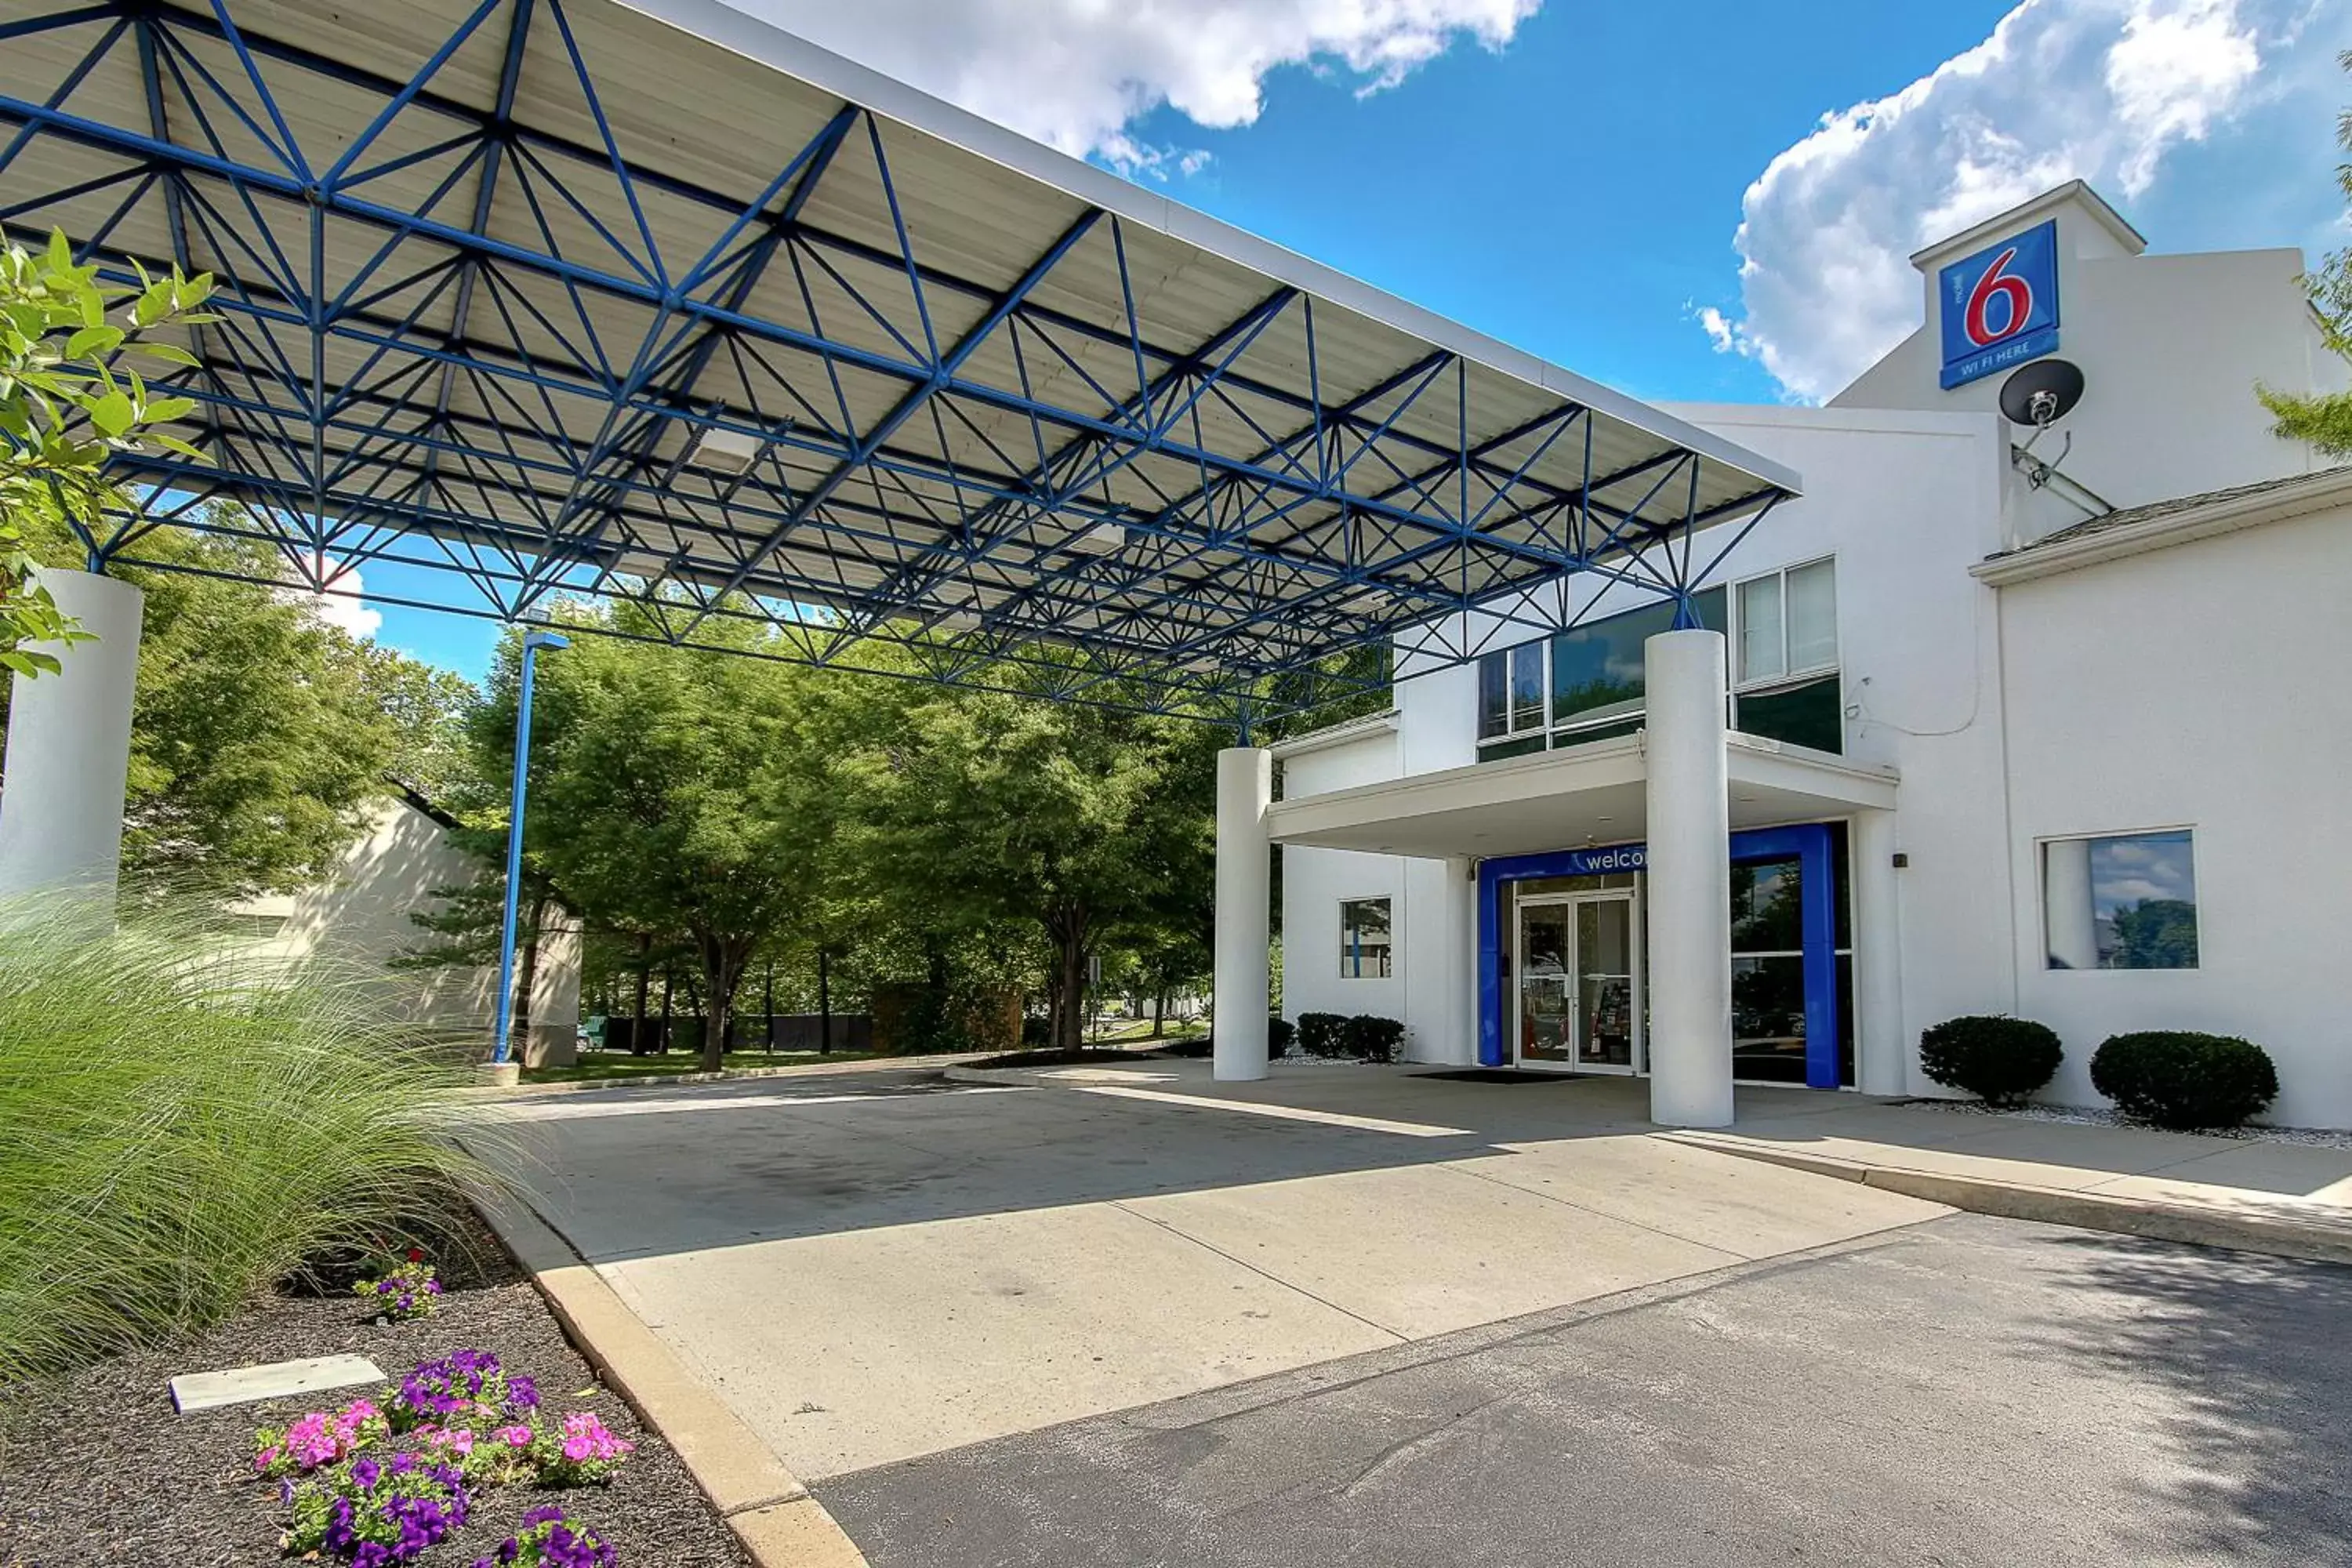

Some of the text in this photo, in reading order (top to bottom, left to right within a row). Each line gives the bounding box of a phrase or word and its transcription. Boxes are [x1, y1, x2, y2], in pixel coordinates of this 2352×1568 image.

[1965, 247, 2033, 347] 6
[1997, 342, 2029, 362] HERE
[1586, 849, 1647, 869] welco
